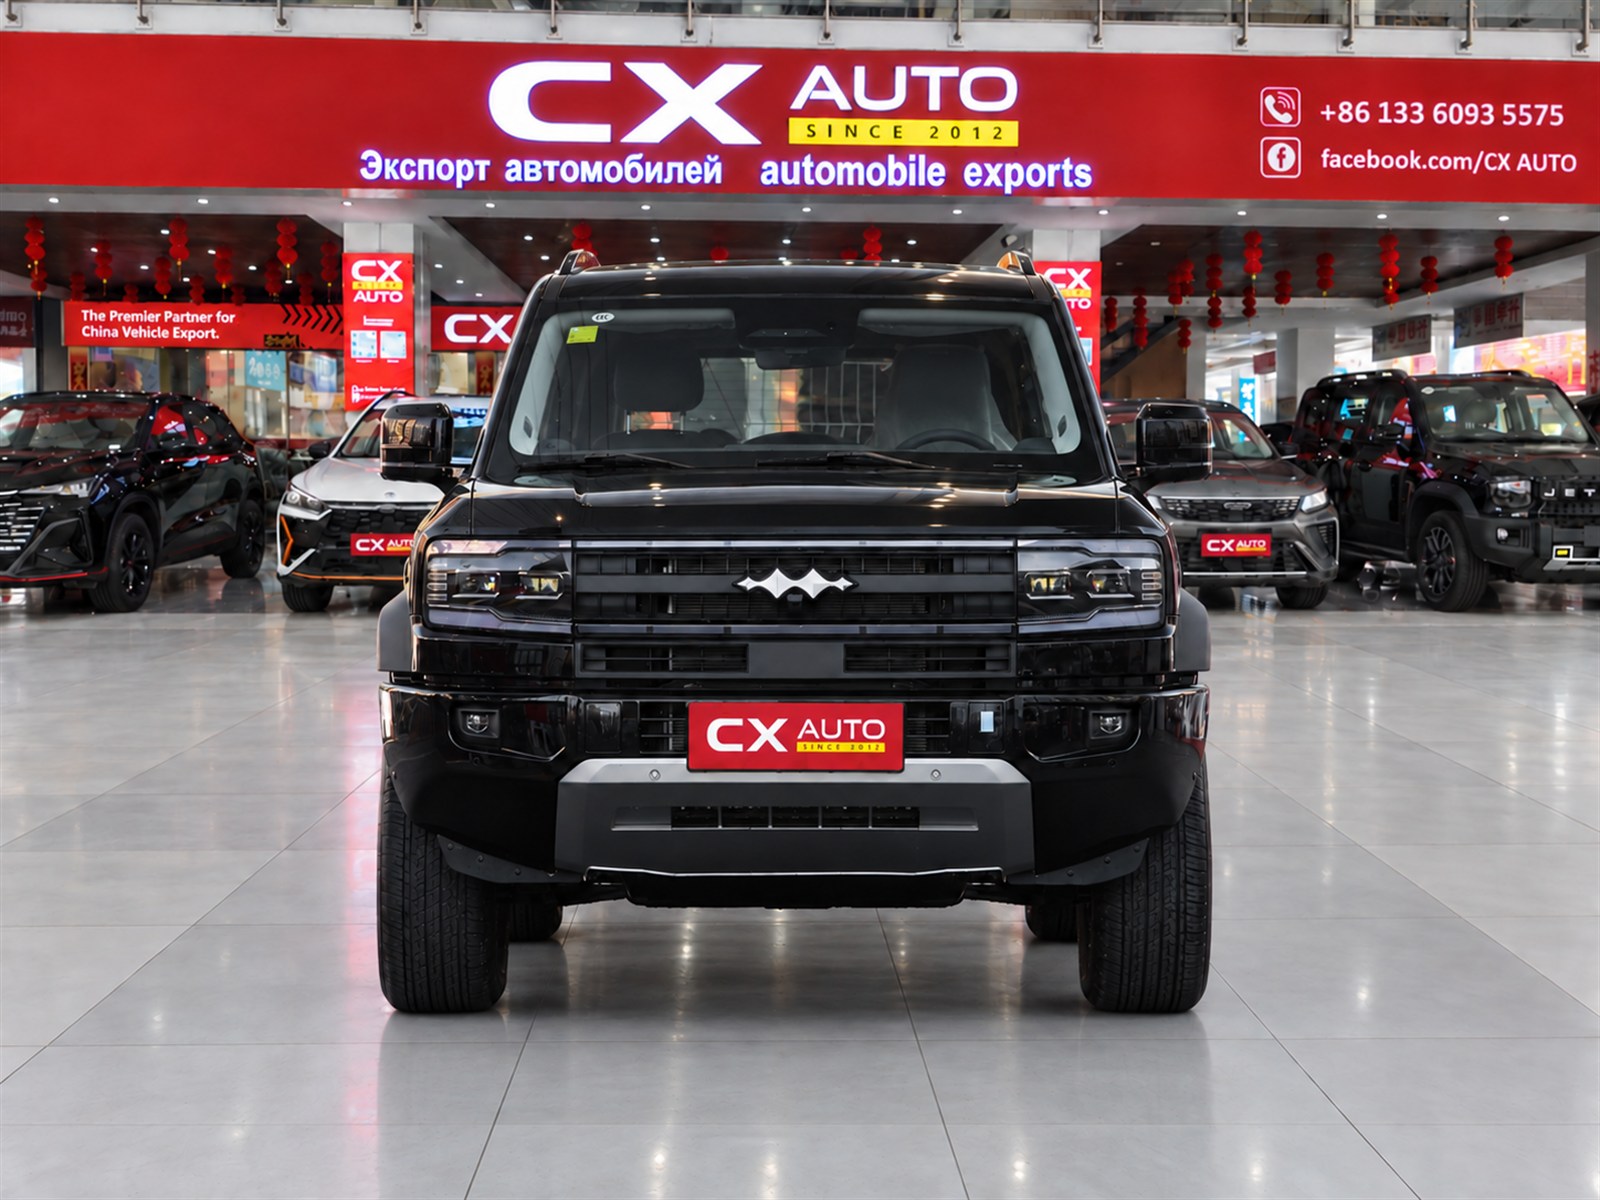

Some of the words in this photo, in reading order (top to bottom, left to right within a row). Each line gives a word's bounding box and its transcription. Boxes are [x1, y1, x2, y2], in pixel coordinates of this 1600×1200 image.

[789, 64, 1018, 112] AUTO
[488, 60, 763, 145] CX
[1320, 101, 1370, 123] +86
[1378, 101, 1425, 124] 133
[1432, 102, 1495, 125] 6093
[1502, 104, 1564, 126] 5575
[806, 123, 904, 139] SINCE
[929, 125, 1003, 140] 2012
[360, 149, 491, 188] Экспорт
[504, 152, 722, 184] автомобилей
[1321, 148, 1511, 175] facebook.com/CX
[1516, 153, 1577, 173] AUTO
[760, 153, 946, 186] automobile
[963, 157, 1093, 195] exports
[351, 259, 403, 282] CX
[353, 290, 404, 303] AUTO
[81, 309, 106, 322] The
[109, 309, 161, 323] Premier
[163, 310, 213, 324] Partner
[215, 310, 236, 324] for
[444, 313, 514, 344] CX
[81, 325, 119, 338] China
[121, 326, 170, 338] Vehicle
[172, 327, 220, 342] Export.
[355, 538, 385, 552] CX
[1206, 539, 1235, 552] CX
[1236, 539, 1267, 548] AUTO
[706, 717, 788, 752] CX
[797, 718, 886, 740] AUTO
